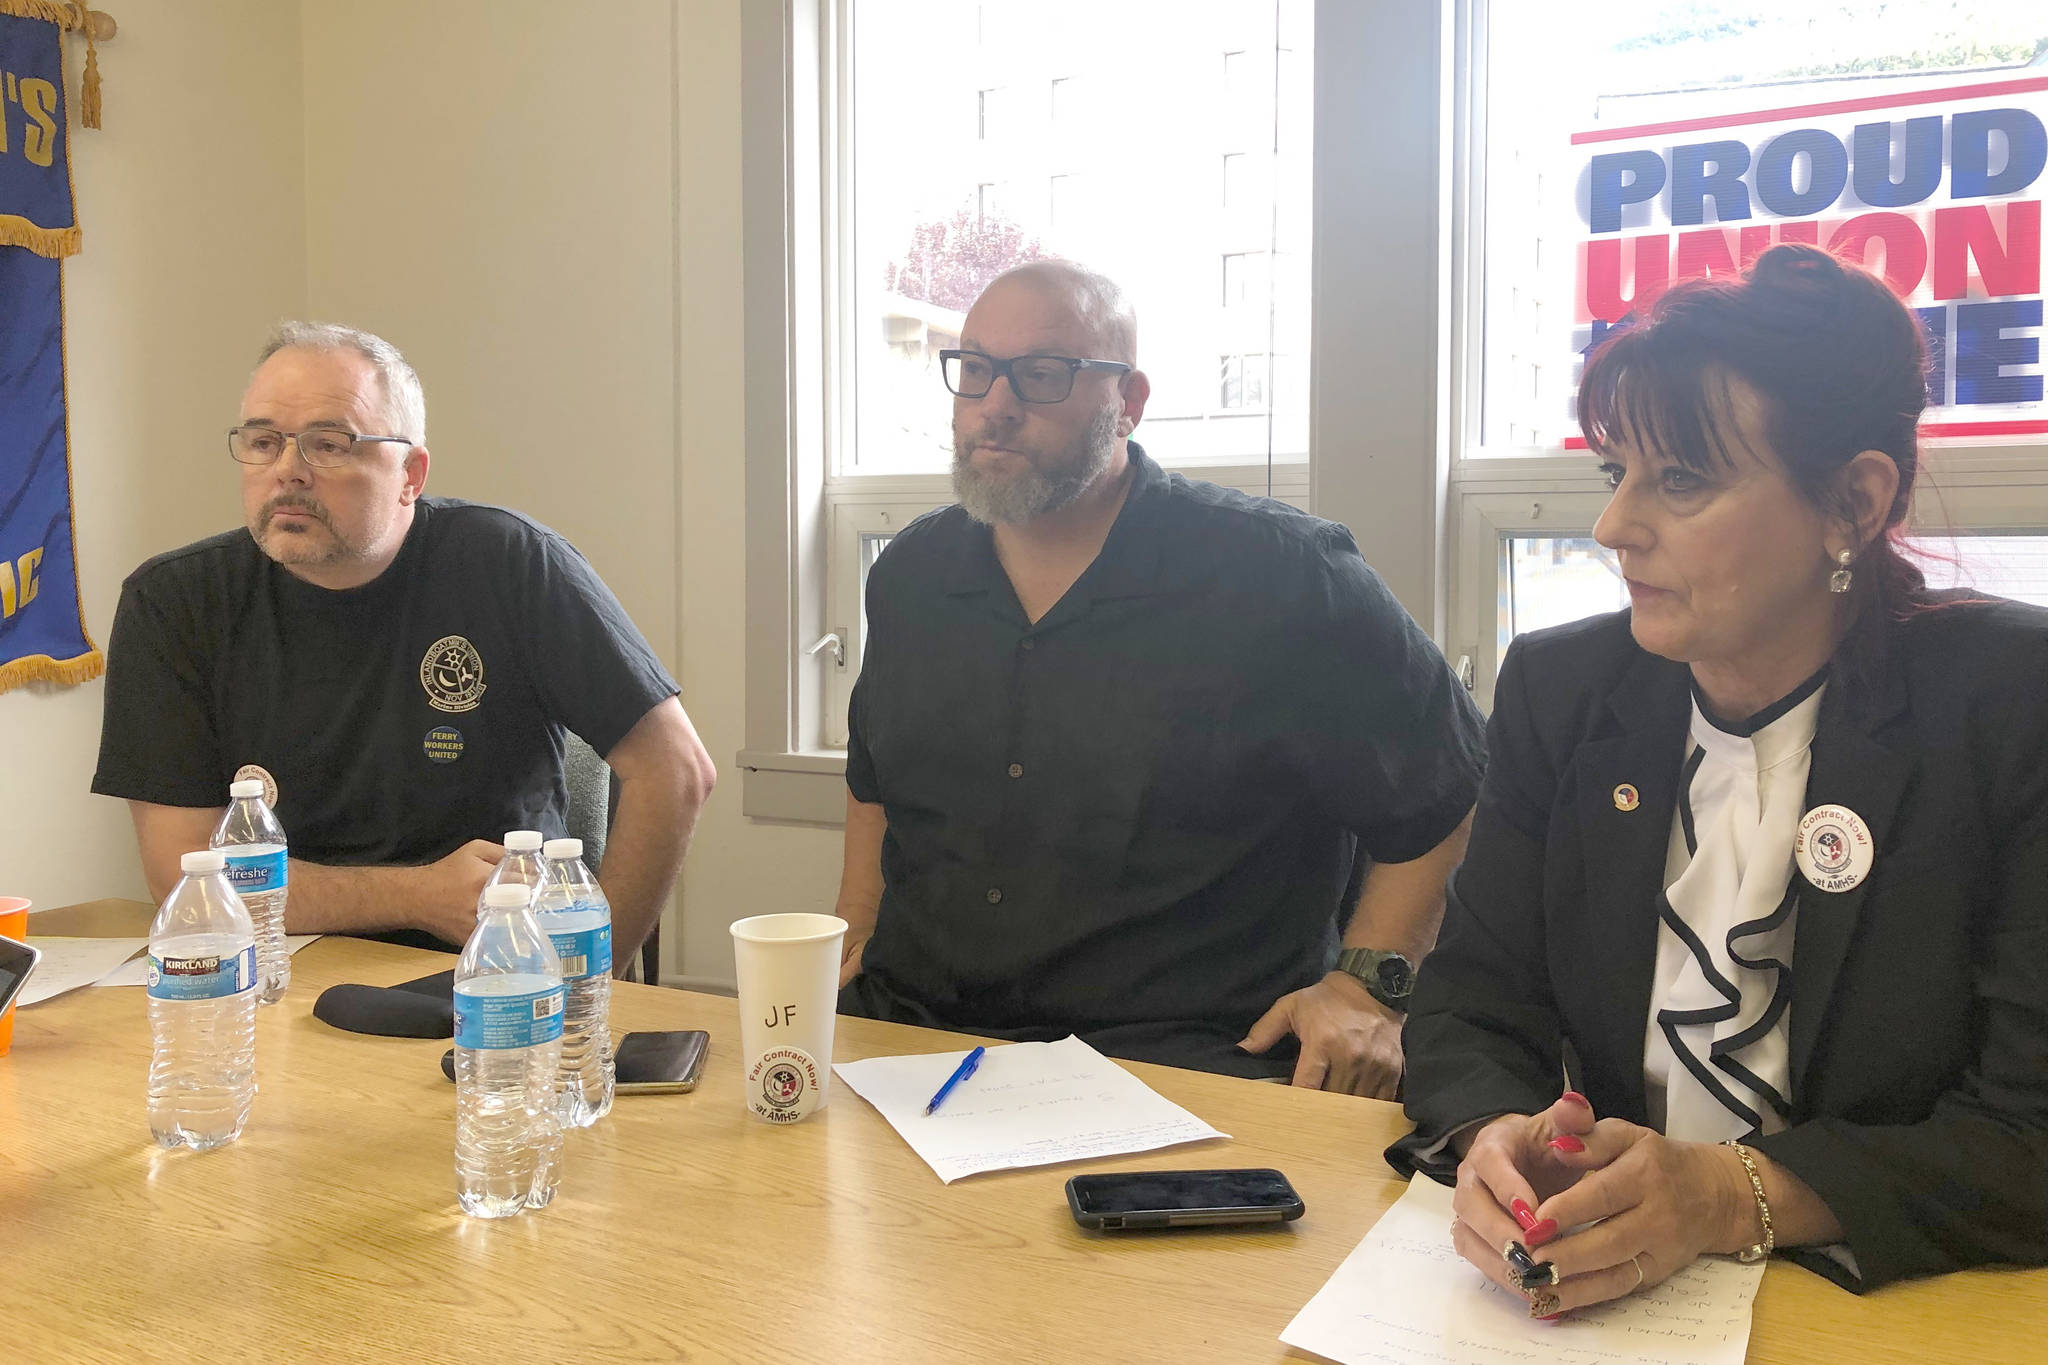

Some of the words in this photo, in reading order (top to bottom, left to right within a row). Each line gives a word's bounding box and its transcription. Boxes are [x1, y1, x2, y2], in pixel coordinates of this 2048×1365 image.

[0, 70, 57, 167] 'S
[1590, 107, 2047, 234] PROUD
[1586, 200, 2041, 324] UNON
[424, 741, 464, 750] WORKERS
[432, 732, 458, 740] FERRY
[428, 751, 458, 759] UNITED
[1796, 830, 1805, 854] Fair
[1846, 817, 1868, 846] Now!
[165, 958, 218, 971] KIRKLAND
[765, 1005, 796, 1028] JF
[749, 1061, 763, 1082] Fair
[763, 1050, 807, 1065] Contract
[805, 1063, 819, 1092] Now!
